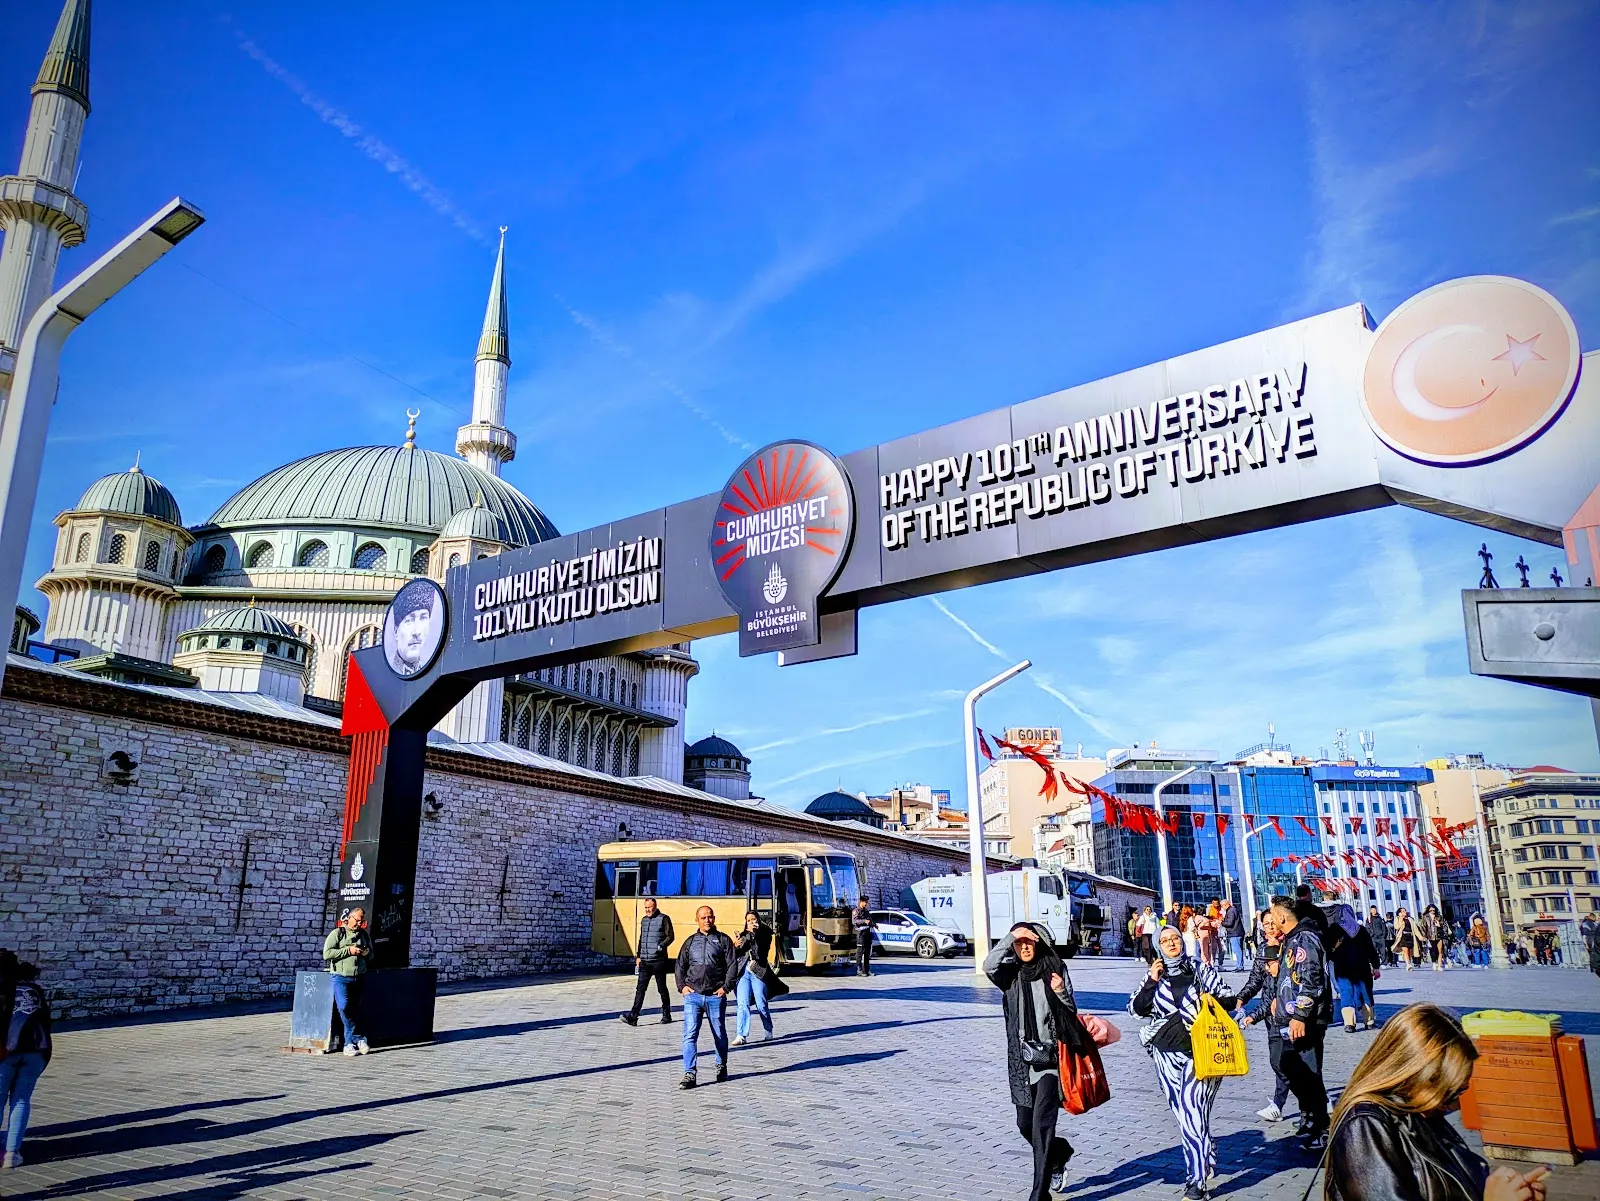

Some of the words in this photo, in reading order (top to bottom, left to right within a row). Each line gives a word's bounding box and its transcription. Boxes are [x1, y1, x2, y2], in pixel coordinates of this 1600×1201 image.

[881, 452, 971, 508] HAPPY
[1052, 361, 1307, 467] ANNIVERSARY
[881, 509, 915, 549] OF
[914, 495, 967, 542] THE
[970, 462, 1110, 528] REPUBLIC
[1113, 450, 1158, 496] OF
[1156, 411, 1317, 485] TÜRKİYE
[726, 495, 829, 543] CUMHURİYET
[746, 523, 805, 558] MÜZESİ
[474, 534, 661, 611] CUMHURİYETİMİZİN
[537, 585, 594, 626] KUTLU
[595, 570, 659, 613] OLSUN
[747, 610, 807, 632] BÜYÜKŞEHİR
[755, 604, 797, 619] İSTANBUL
